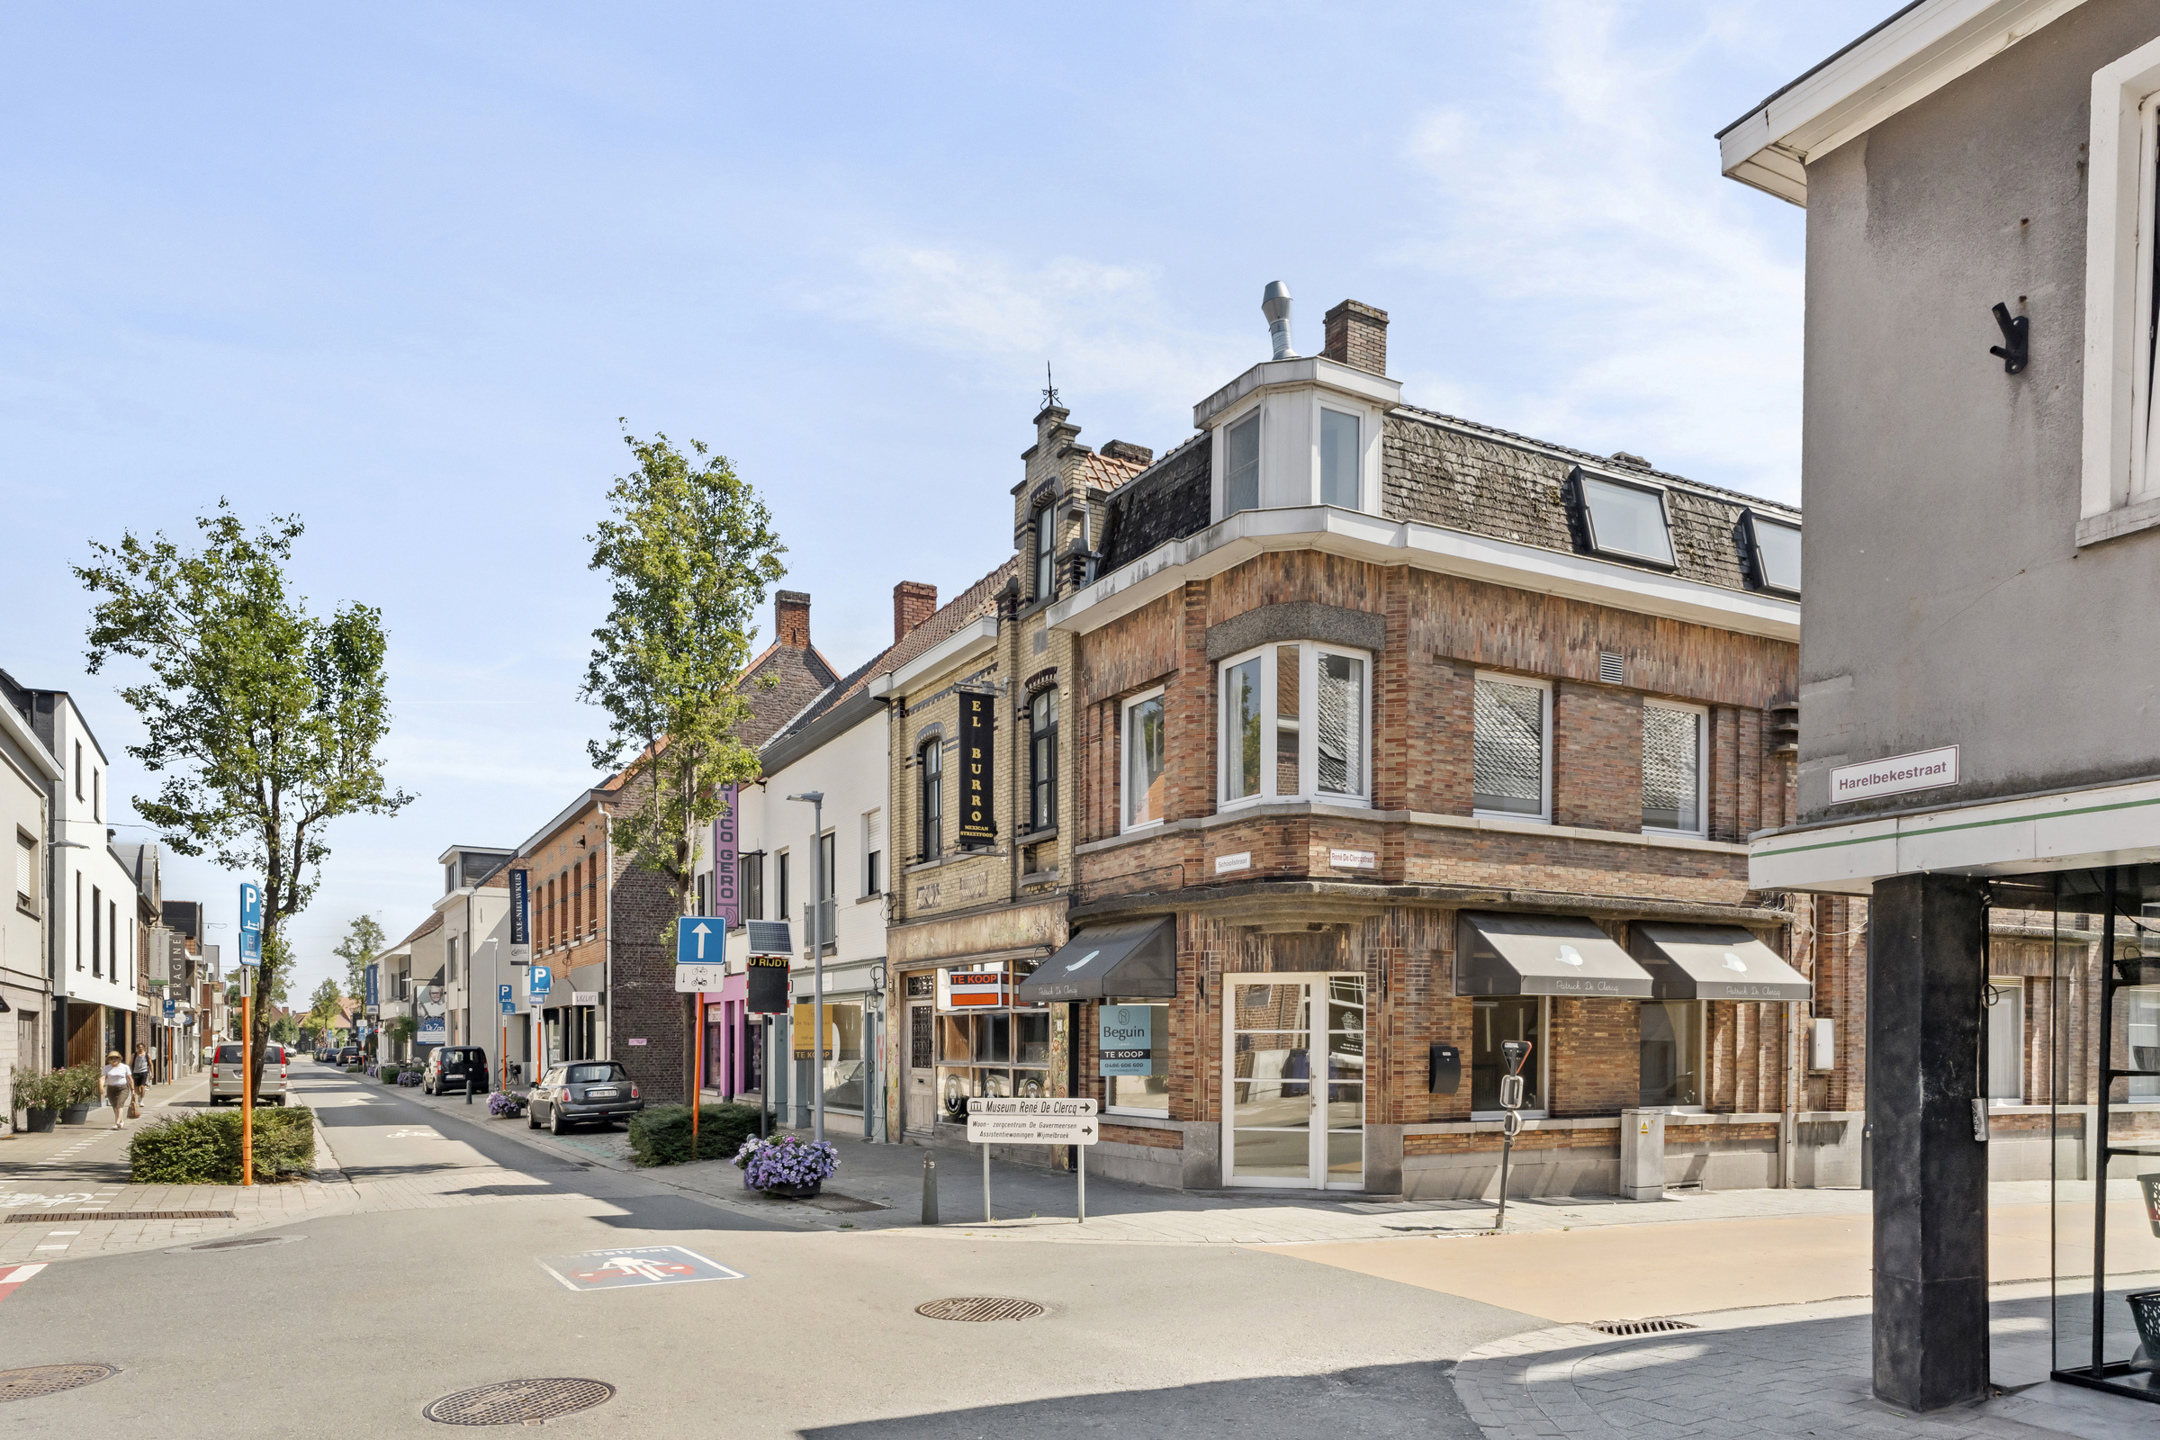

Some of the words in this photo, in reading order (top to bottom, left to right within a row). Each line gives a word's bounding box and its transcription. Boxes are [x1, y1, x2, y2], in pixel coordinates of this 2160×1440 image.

[972, 700, 981, 727] EL
[1839, 761, 1947, 790] Harelbekestraat
[971, 748, 981, 821] BURRO
[960, 830, 994, 838] STREETFOOD
[1218, 857, 1247, 869] Schoolstraat
[1331, 852, 1343, 861] René
[1343, 853, 1349, 862] De
[720, 849, 734, 899] GERO
[246, 887, 257, 912] P
[514, 872, 523, 942] LUXE-NIEUWKUIS
[172, 939, 182, 996] FRAGINE
[749, 958, 756, 967] U
[759, 958, 788, 968] RIJDT
[534, 968, 547, 984] P
[951, 975, 965, 984] TE
[968, 974, 998, 983] KOOP
[501, 986, 510, 996] P
[1556, 980, 1581, 991] Patrick
[1584, 980, 1594, 990] De
[1597, 980, 1619, 993] Clercq
[1726, 985, 1749, 996] Patrick
[1751, 986, 1760, 995] De
[1762, 986, 1781, 997] Clercq
[165, 1000, 173, 1008] P
[1103, 1026, 1145, 1041] Beguin
[795, 1051, 806, 1059] TE
[986, 1101, 1017, 1113] Museum
[1019, 1101, 1038, 1113] René
[1040, 1101, 1051, 1113] De
[1053, 1101, 1078, 1115] Clercq
[972, 1120, 990, 1128] Woon-
[992, 1121, 1027, 1130] zorgcentrum
[1039, 1121, 1077, 1129] Gavermeersen
[979, 1130, 1034, 1139] Assistentiewoningen
[1036, 1131, 1069, 1139] Wijmelbroek
